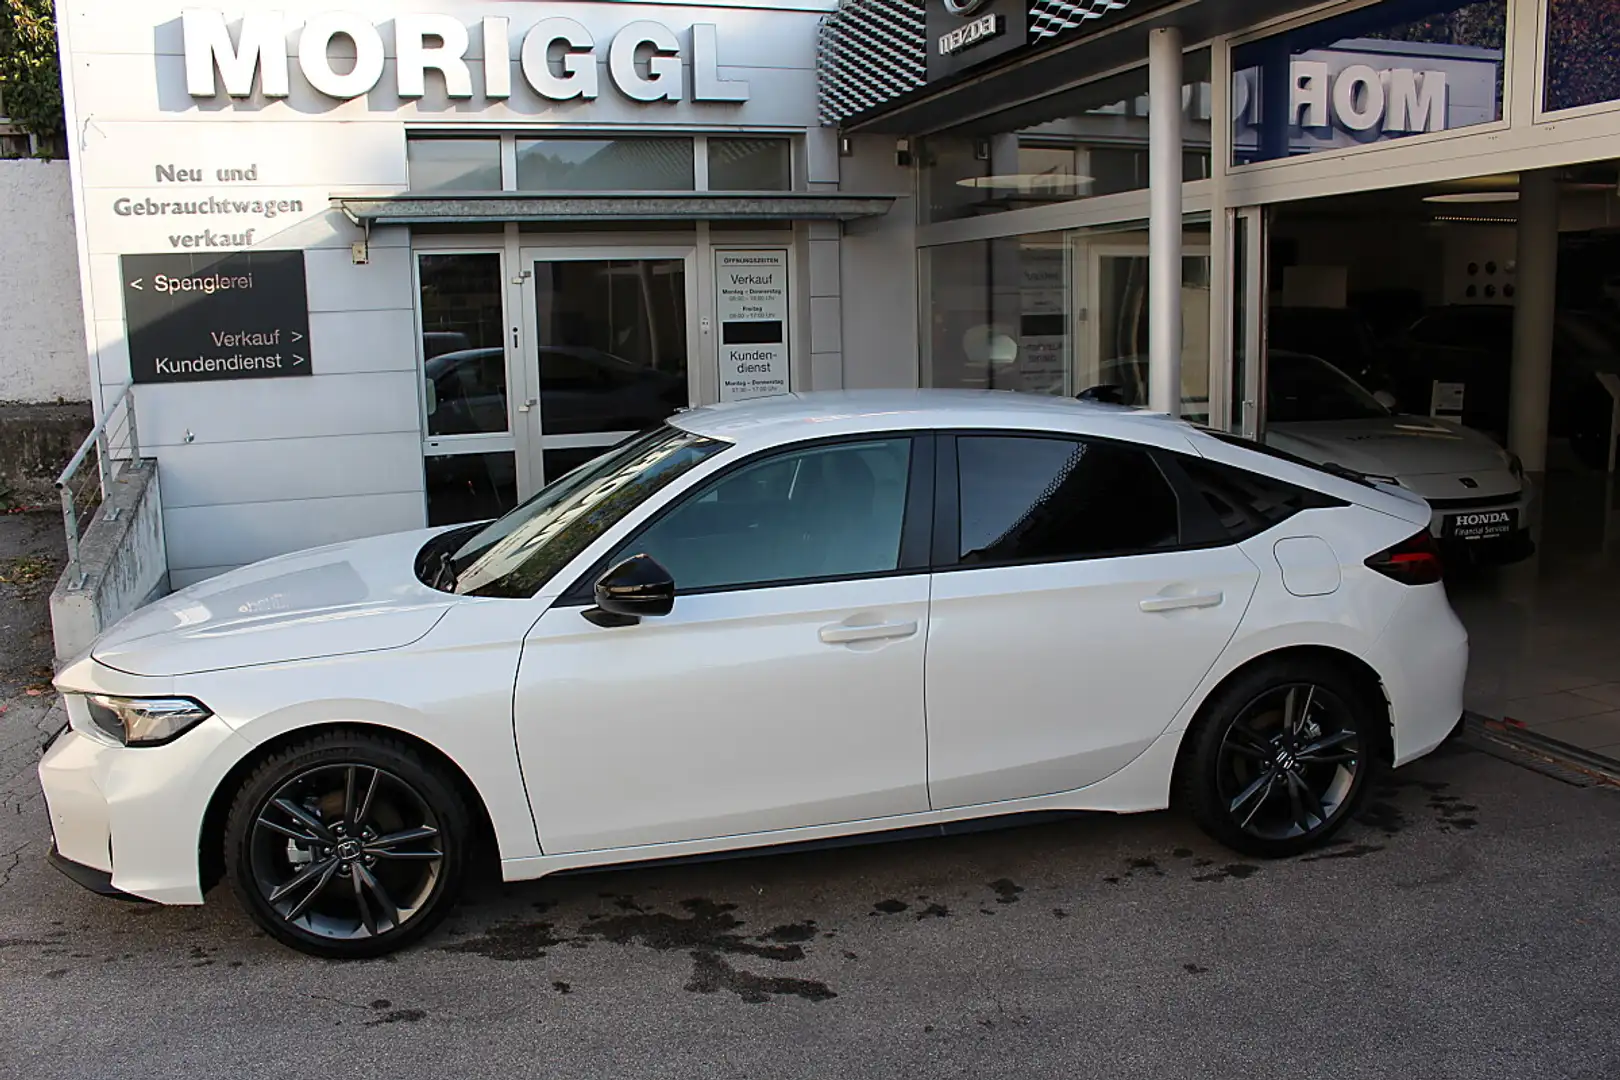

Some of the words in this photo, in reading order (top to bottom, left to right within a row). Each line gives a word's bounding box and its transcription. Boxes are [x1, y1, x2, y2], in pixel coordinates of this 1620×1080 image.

[180, 8, 749, 104] MORIGGL
[155, 164, 202, 182] Neu
[216, 163, 258, 182] und
[113, 196, 304, 218] Gebrauchtwagen
[169, 228, 255, 248] verkauf
[154, 272, 253, 295] Spenglerei
[730, 273, 773, 285] Verkauf
[211, 329, 281, 348] Verkauf
[156, 353, 282, 375] Kundendienst
[730, 350, 778, 361] Kunden-
[737, 362, 771, 374] dienst
[1456, 512, 1510, 526] HONDA
[1454, 527, 1484, 537] Financial
[1484, 525, 1510, 534] Services
